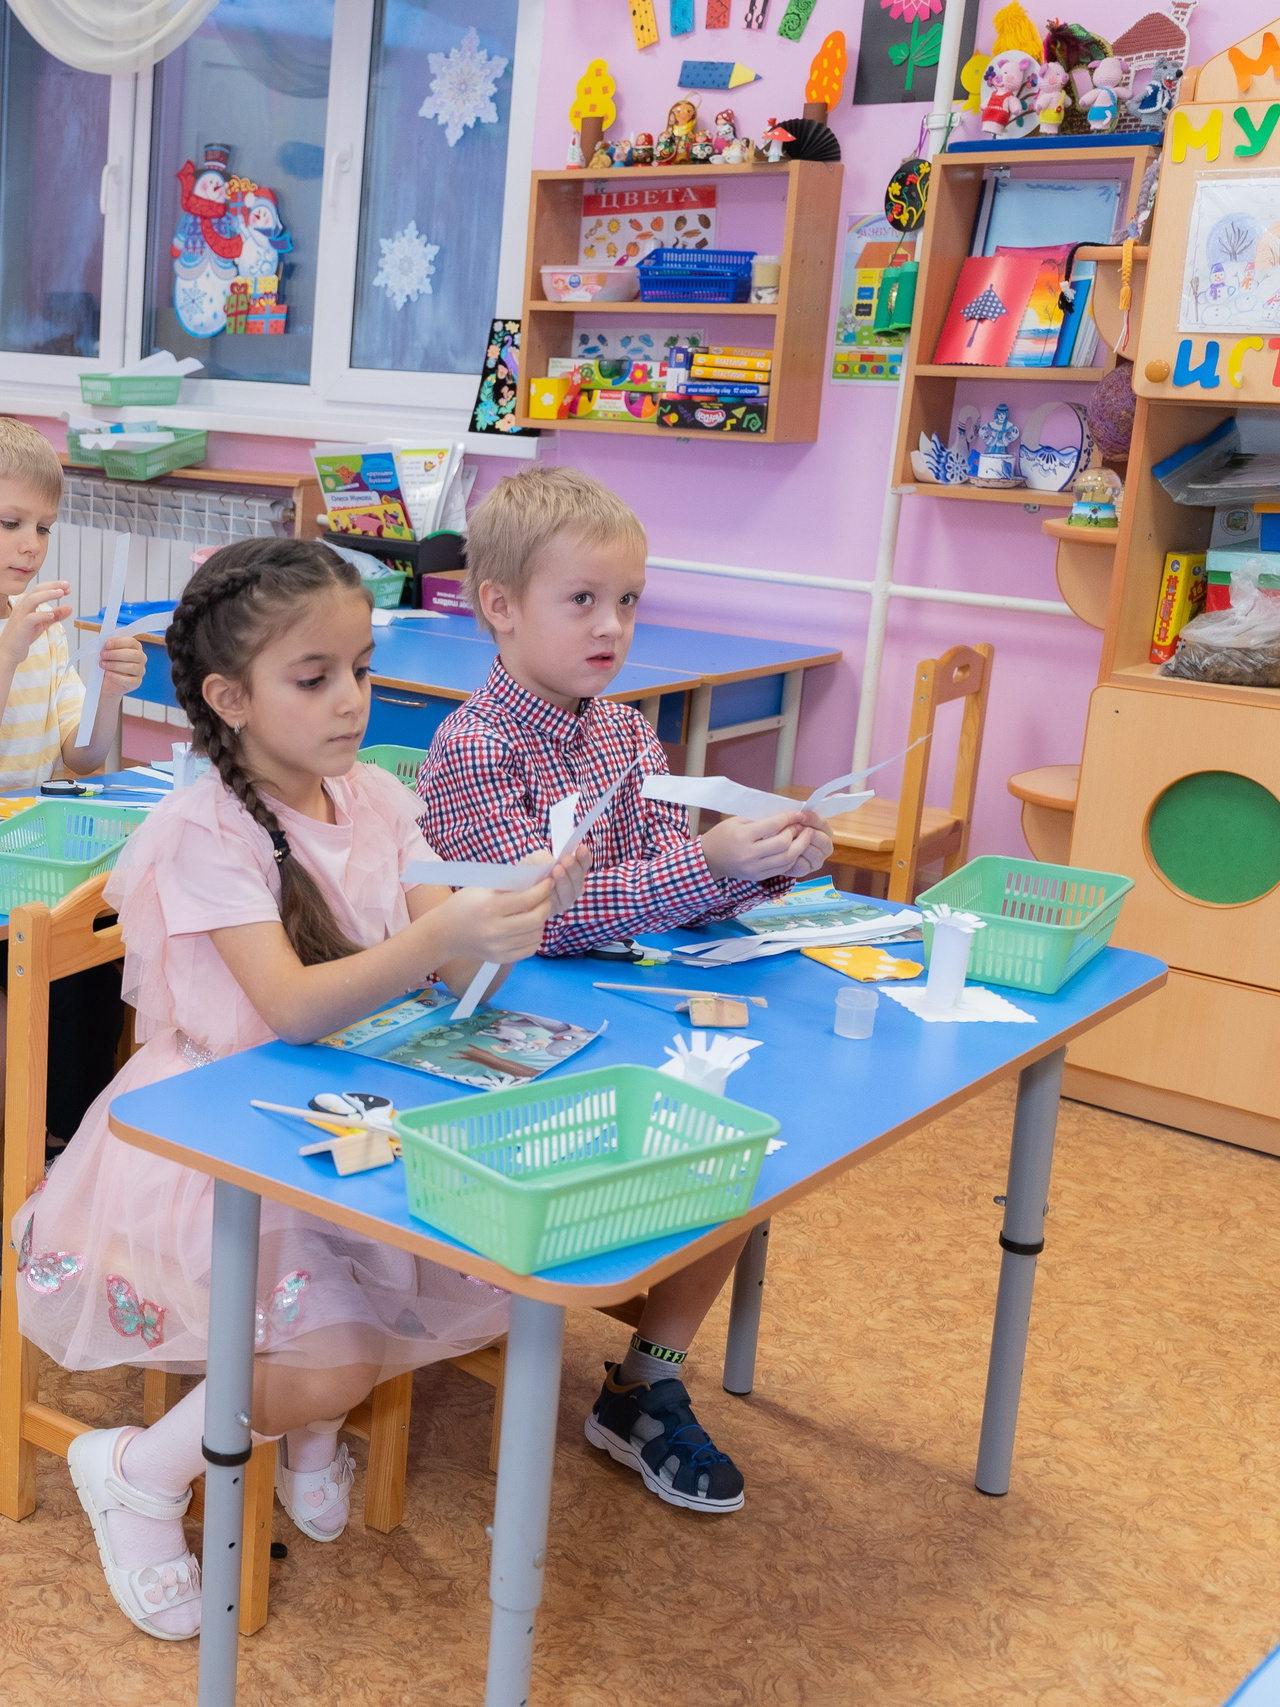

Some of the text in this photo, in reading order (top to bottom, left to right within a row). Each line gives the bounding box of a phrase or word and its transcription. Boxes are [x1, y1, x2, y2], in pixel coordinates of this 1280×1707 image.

[600, 187, 698, 209] ЦВЕТА
[715, 357, 748, 367] ПЛАСТИЛИН
[712, 370, 746, 379] ПЛАСТИЛИН
[699, 386, 721, 395] modelling
[720, 387, 732, 395] clay
